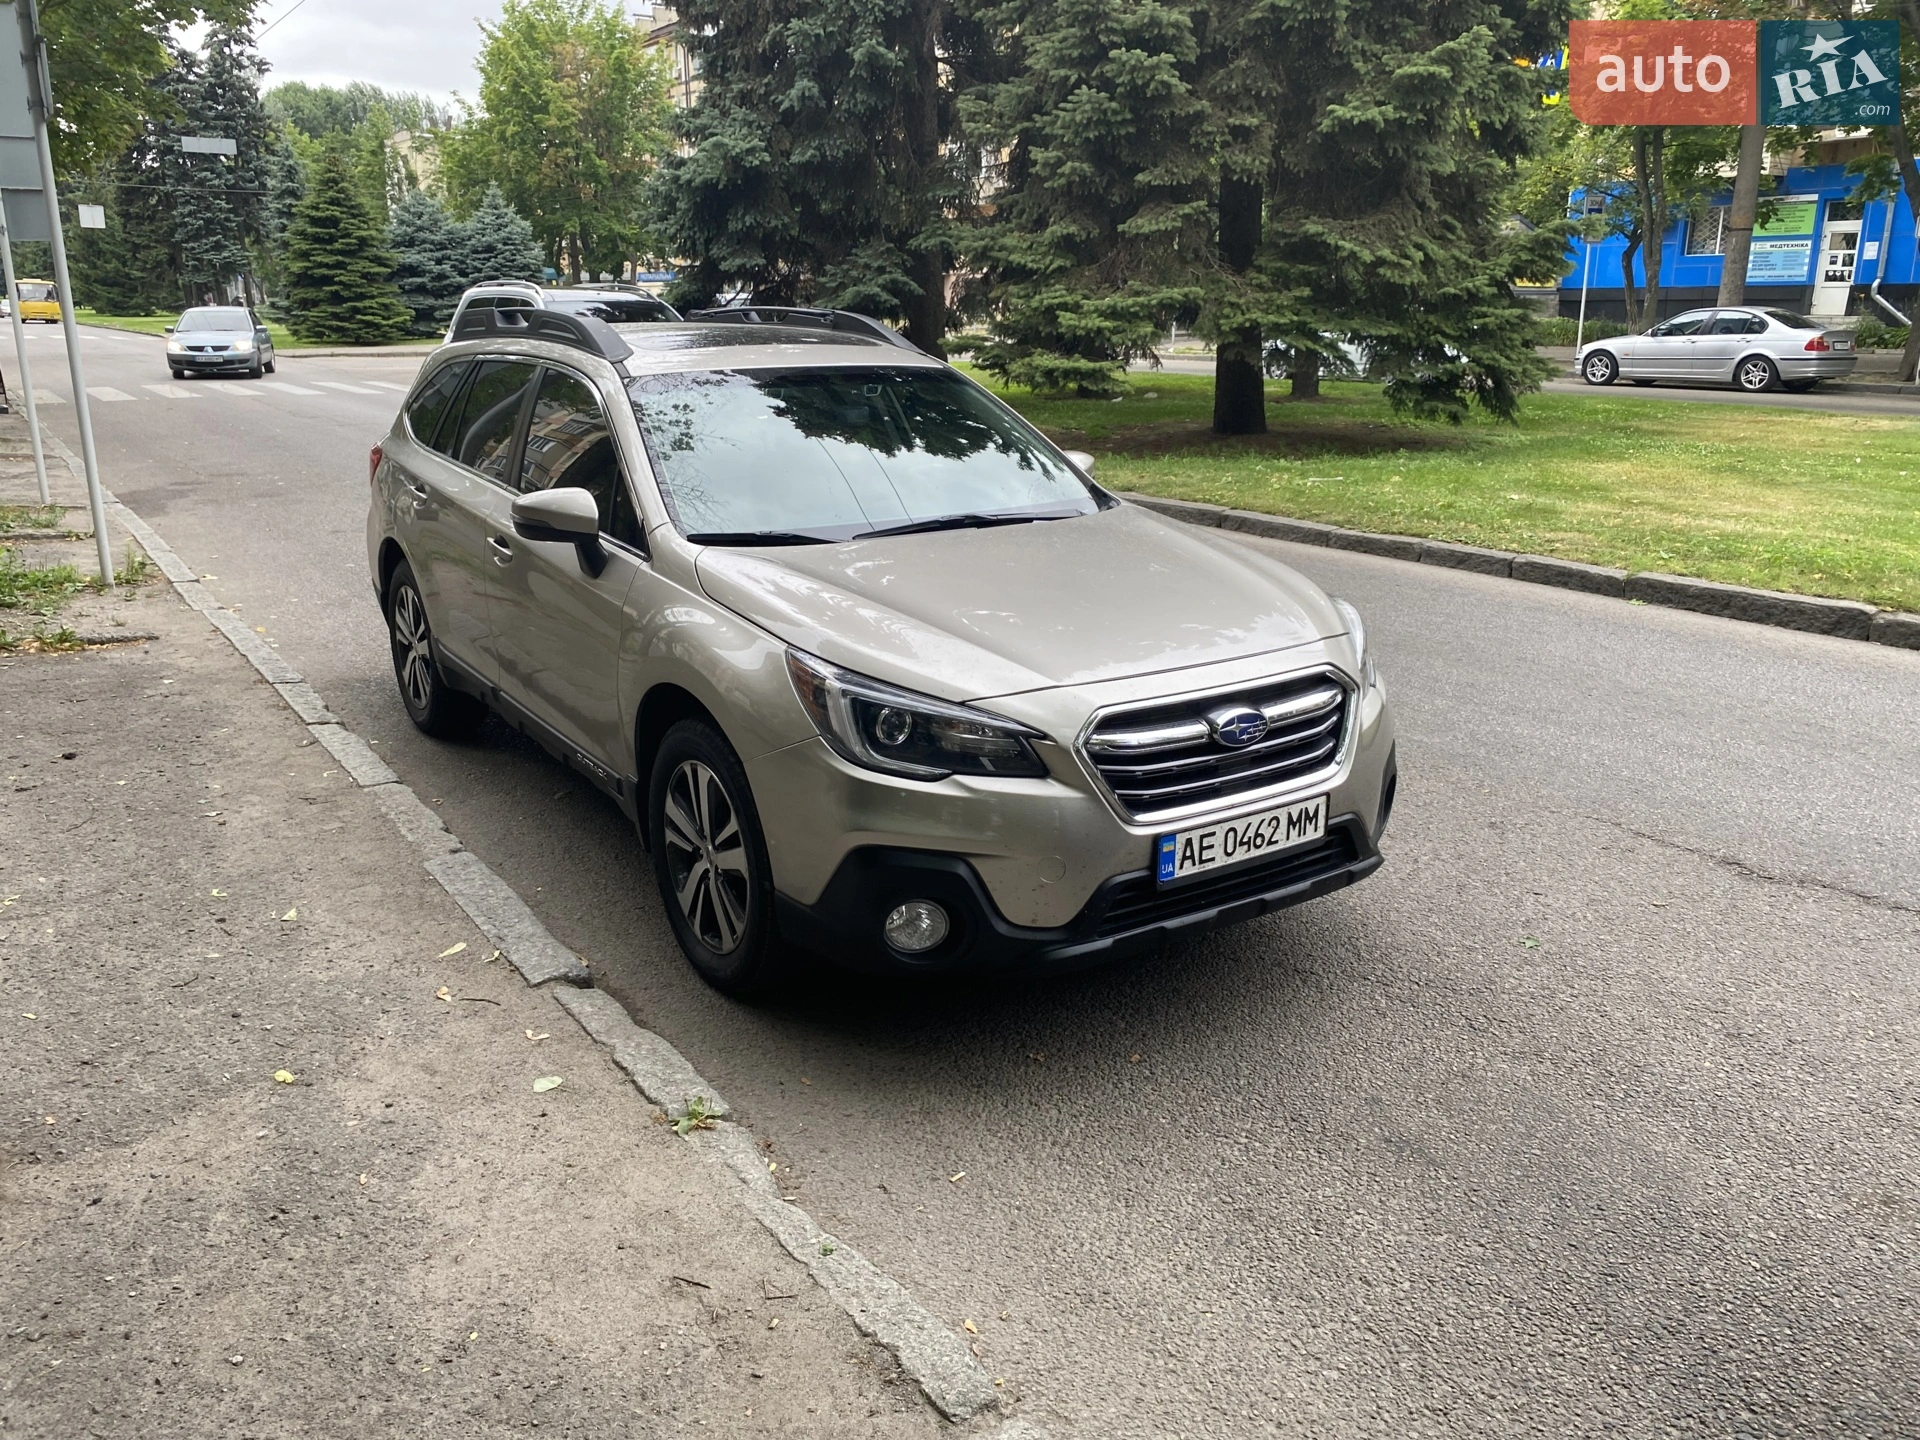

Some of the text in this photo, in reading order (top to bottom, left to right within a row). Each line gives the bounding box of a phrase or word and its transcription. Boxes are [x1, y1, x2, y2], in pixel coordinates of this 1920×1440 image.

[1179, 803, 1320, 870] AE 0462 MM
[1162, 863, 1174, 874] UA
